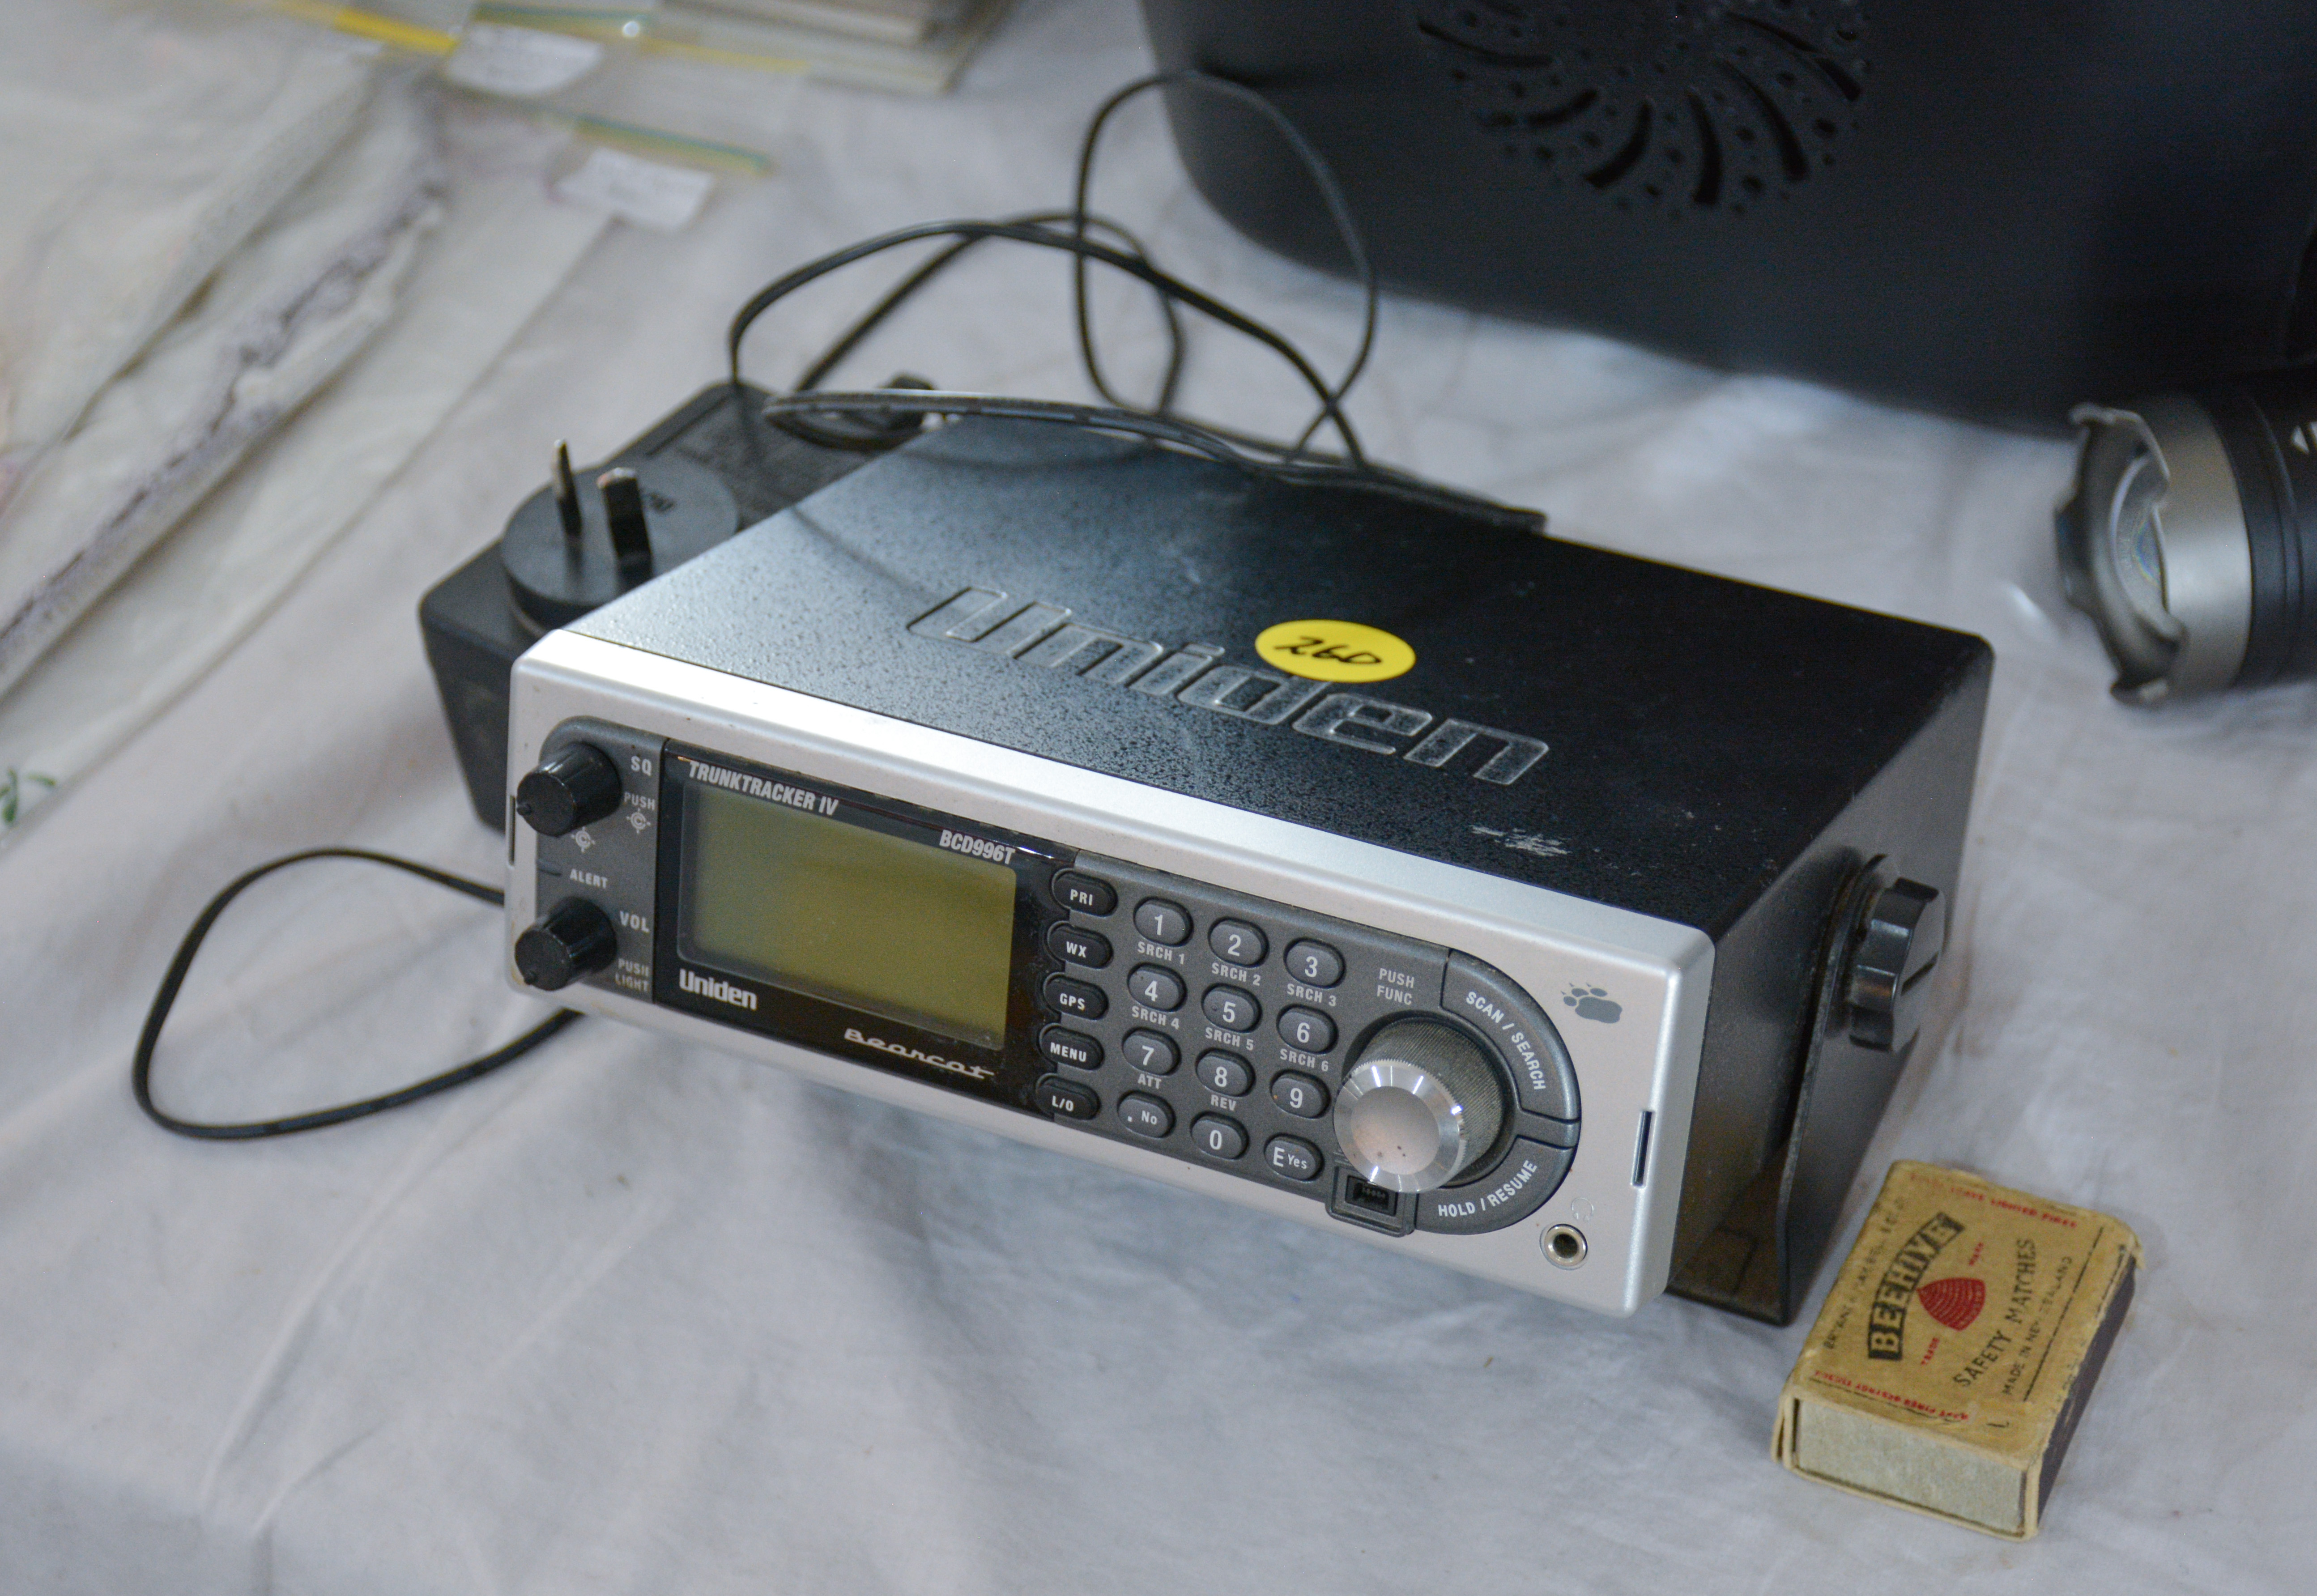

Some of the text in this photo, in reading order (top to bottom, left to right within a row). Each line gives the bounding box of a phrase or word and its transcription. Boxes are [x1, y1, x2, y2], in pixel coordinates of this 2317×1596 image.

[906, 586, 1549, 786] Uniden
[630, 756, 652, 776] SQ
[689, 760, 839, 816] TRUNKTRACKER IV
[623, 792, 656, 810] PUSH
[940, 829, 1016, 865] BCD996T
[569, 868, 608, 889] ALERT
[1070, 889, 1093, 906] PRI
[619, 911, 650, 932] VOL
[1154, 914, 1163, 936] 1
[1066, 941, 1087, 958] WX
[1137, 941, 1185, 965] SRCH 1
[1227, 934, 1241, 957] 2
[618, 958, 649, 976] PUSH
[1211, 962, 1261, 986] SRCH 2
[1304, 956, 1318, 978] 3
[1378, 967, 1415, 989] PUSH
[615, 974, 649, 992] LIGHT
[679, 969, 758, 1011] Uniden
[1144, 980, 1158, 1002] 4
[1059, 992, 1085, 1011] GPS
[1287, 983, 1337, 1007] SRCH 3
[1376, 985, 1413, 1006] FUNC
[1132, 1006, 1180, 1030] SRCH 4
[1222, 1000, 1236, 1023] 5
[1205, 1026, 1254, 1051] SRCH 5
[1297, 1021, 1310, 1043] 6
[1465, 990, 1503, 1024] SCAN
[1511, 1031, 1546, 1091] SEARCH
[843, 1028, 995, 1080] Bearcat
[1050, 1042, 1087, 1063] MENU
[1141, 1045, 1154, 1066] 7
[1280, 1048, 1329, 1072] SRCH 6
[1137, 1073, 1162, 1090] ATT
[1214, 1066, 1227, 1088] 8
[1052, 1095, 1074, 1112] L/O
[1210, 1094, 1237, 1111] REV
[1289, 1087, 1303, 1109] 9
[1209, 1129, 1222, 1150] 0
[1438, 1159, 1538, 1218] HOLD / RESUME
[1870, 1213, 1962, 1357] BEEHIVE
[1952, 1329, 2012, 1387] SAFETY
[2005, 1238, 2036, 1324] MATCHES
[2002, 1362, 2025, 1396] MADE
[2019, 1345, 2032, 1358] IN
